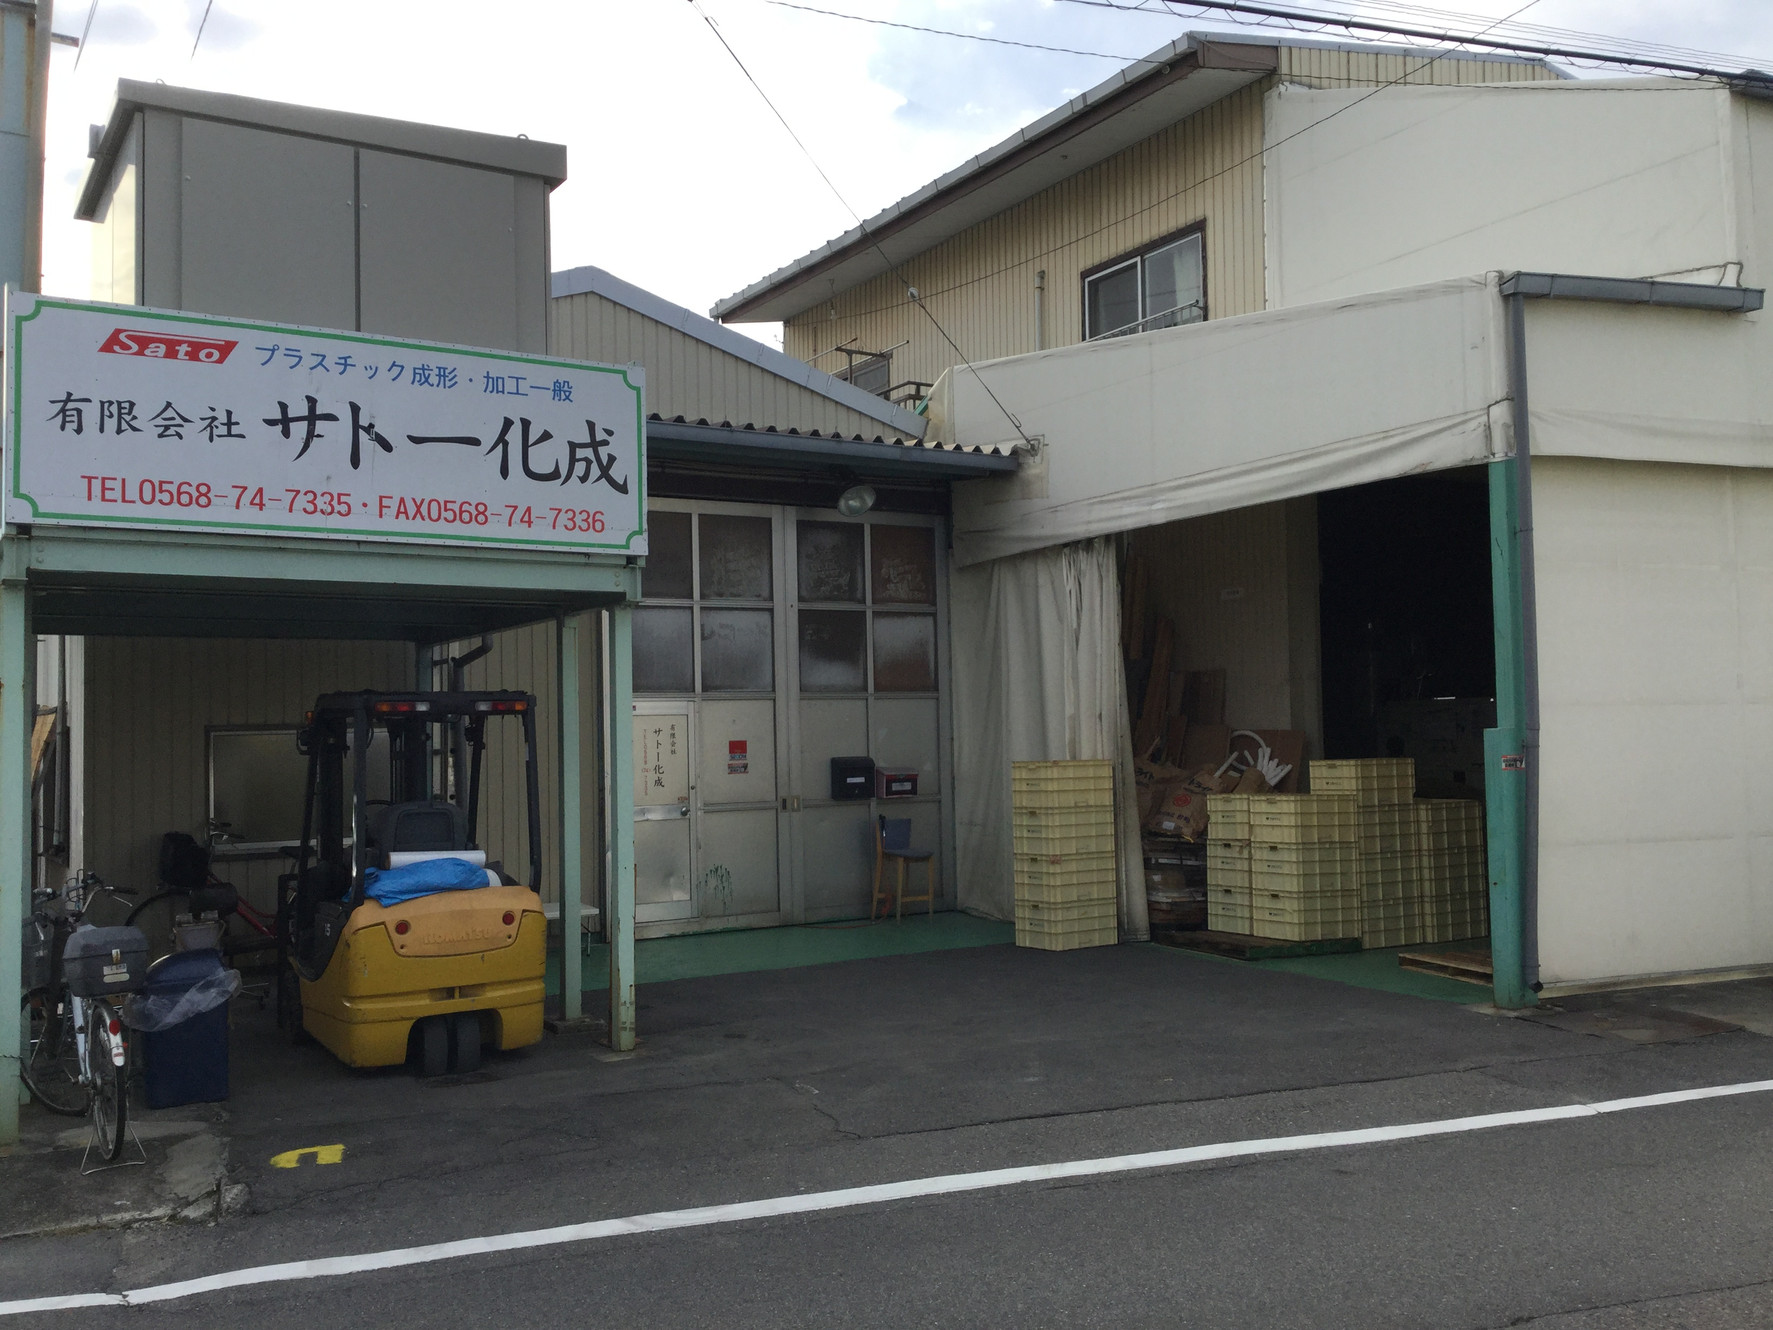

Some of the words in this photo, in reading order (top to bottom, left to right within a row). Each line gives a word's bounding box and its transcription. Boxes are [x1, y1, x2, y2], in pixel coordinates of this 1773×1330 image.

[113, 331, 225, 363] Sato
[255, 344, 573, 404] プラスチック成形・加工一般
[46, 391, 247, 444] 有限会社
[653, 727, 665, 788] サトー化成
